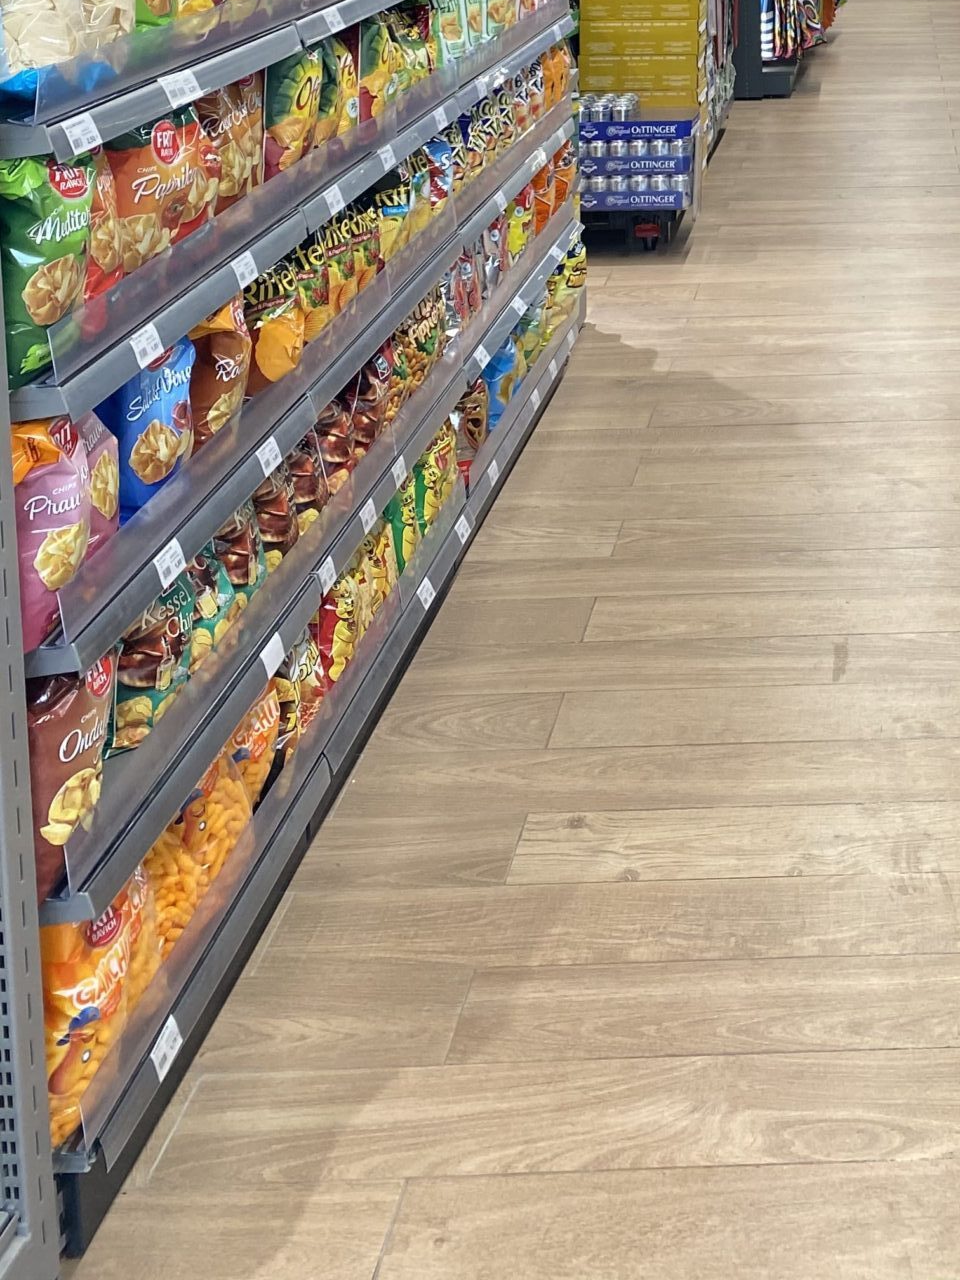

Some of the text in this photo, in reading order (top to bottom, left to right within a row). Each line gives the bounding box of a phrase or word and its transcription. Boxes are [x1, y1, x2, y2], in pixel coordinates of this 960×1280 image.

[52, 482, 77, 495] CHIPS
[141, 581, 192, 630] Kessel
[166, 611, 195, 638] Chip
